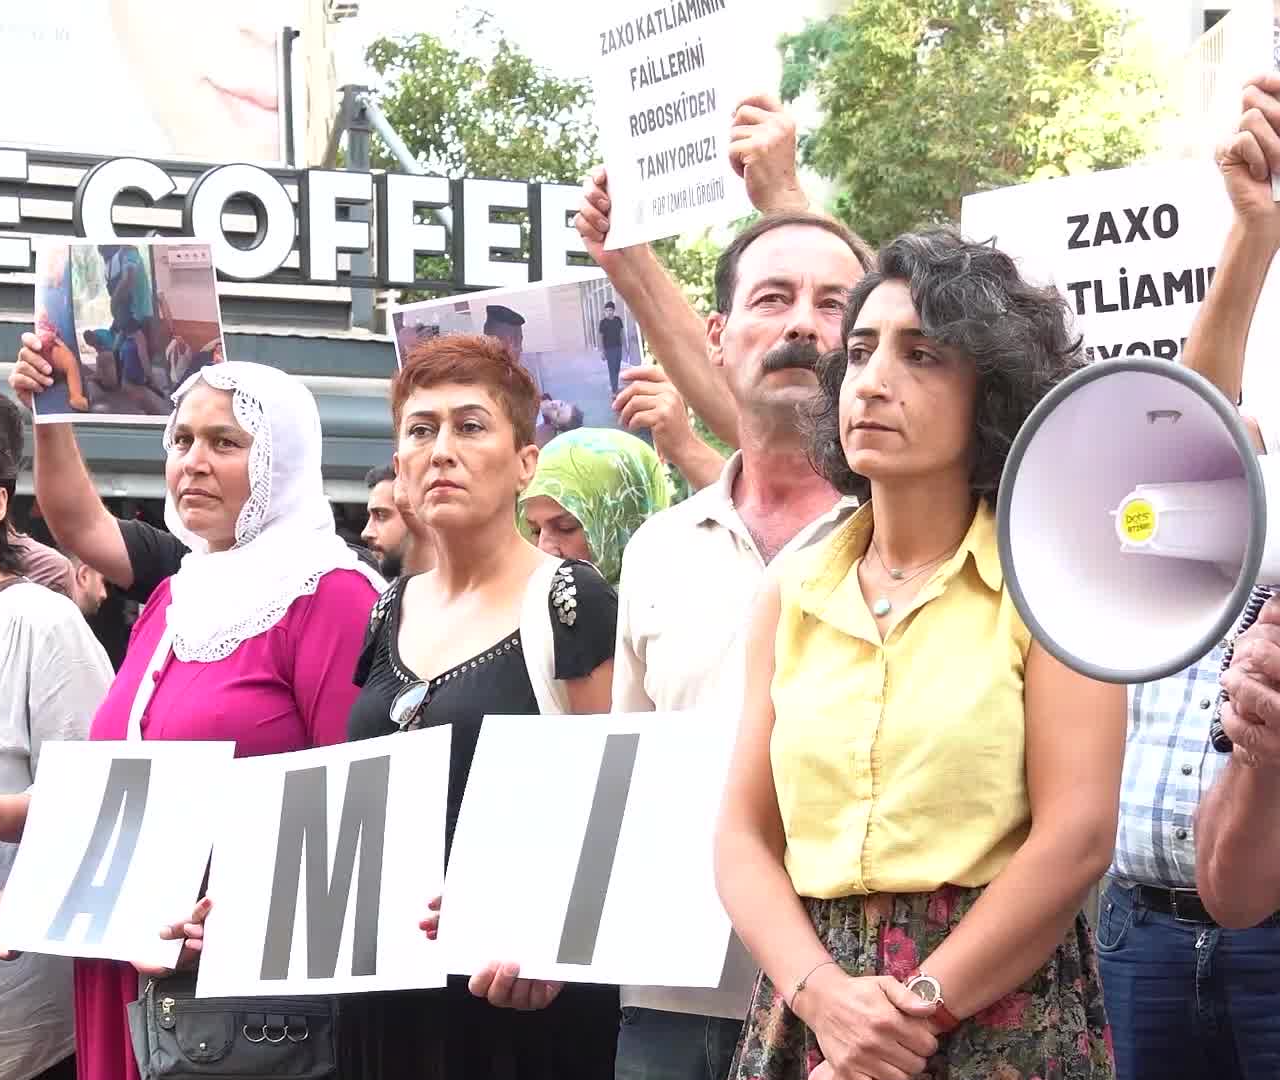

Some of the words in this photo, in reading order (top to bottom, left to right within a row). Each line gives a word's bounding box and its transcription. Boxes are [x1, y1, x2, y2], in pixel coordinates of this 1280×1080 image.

[600, 22, 634, 56] ZAXO
[630, 36, 705, 92] FAİLLERİNİ
[637, 136, 717, 180] TANIYORUZ!
[77, 156, 607, 288] COFFEE
[1067, 204, 1179, 249] ZAXO
[46, 759, 152, 944] A
[260, 755, 391, 981] M
[556, 733, 640, 965] I
